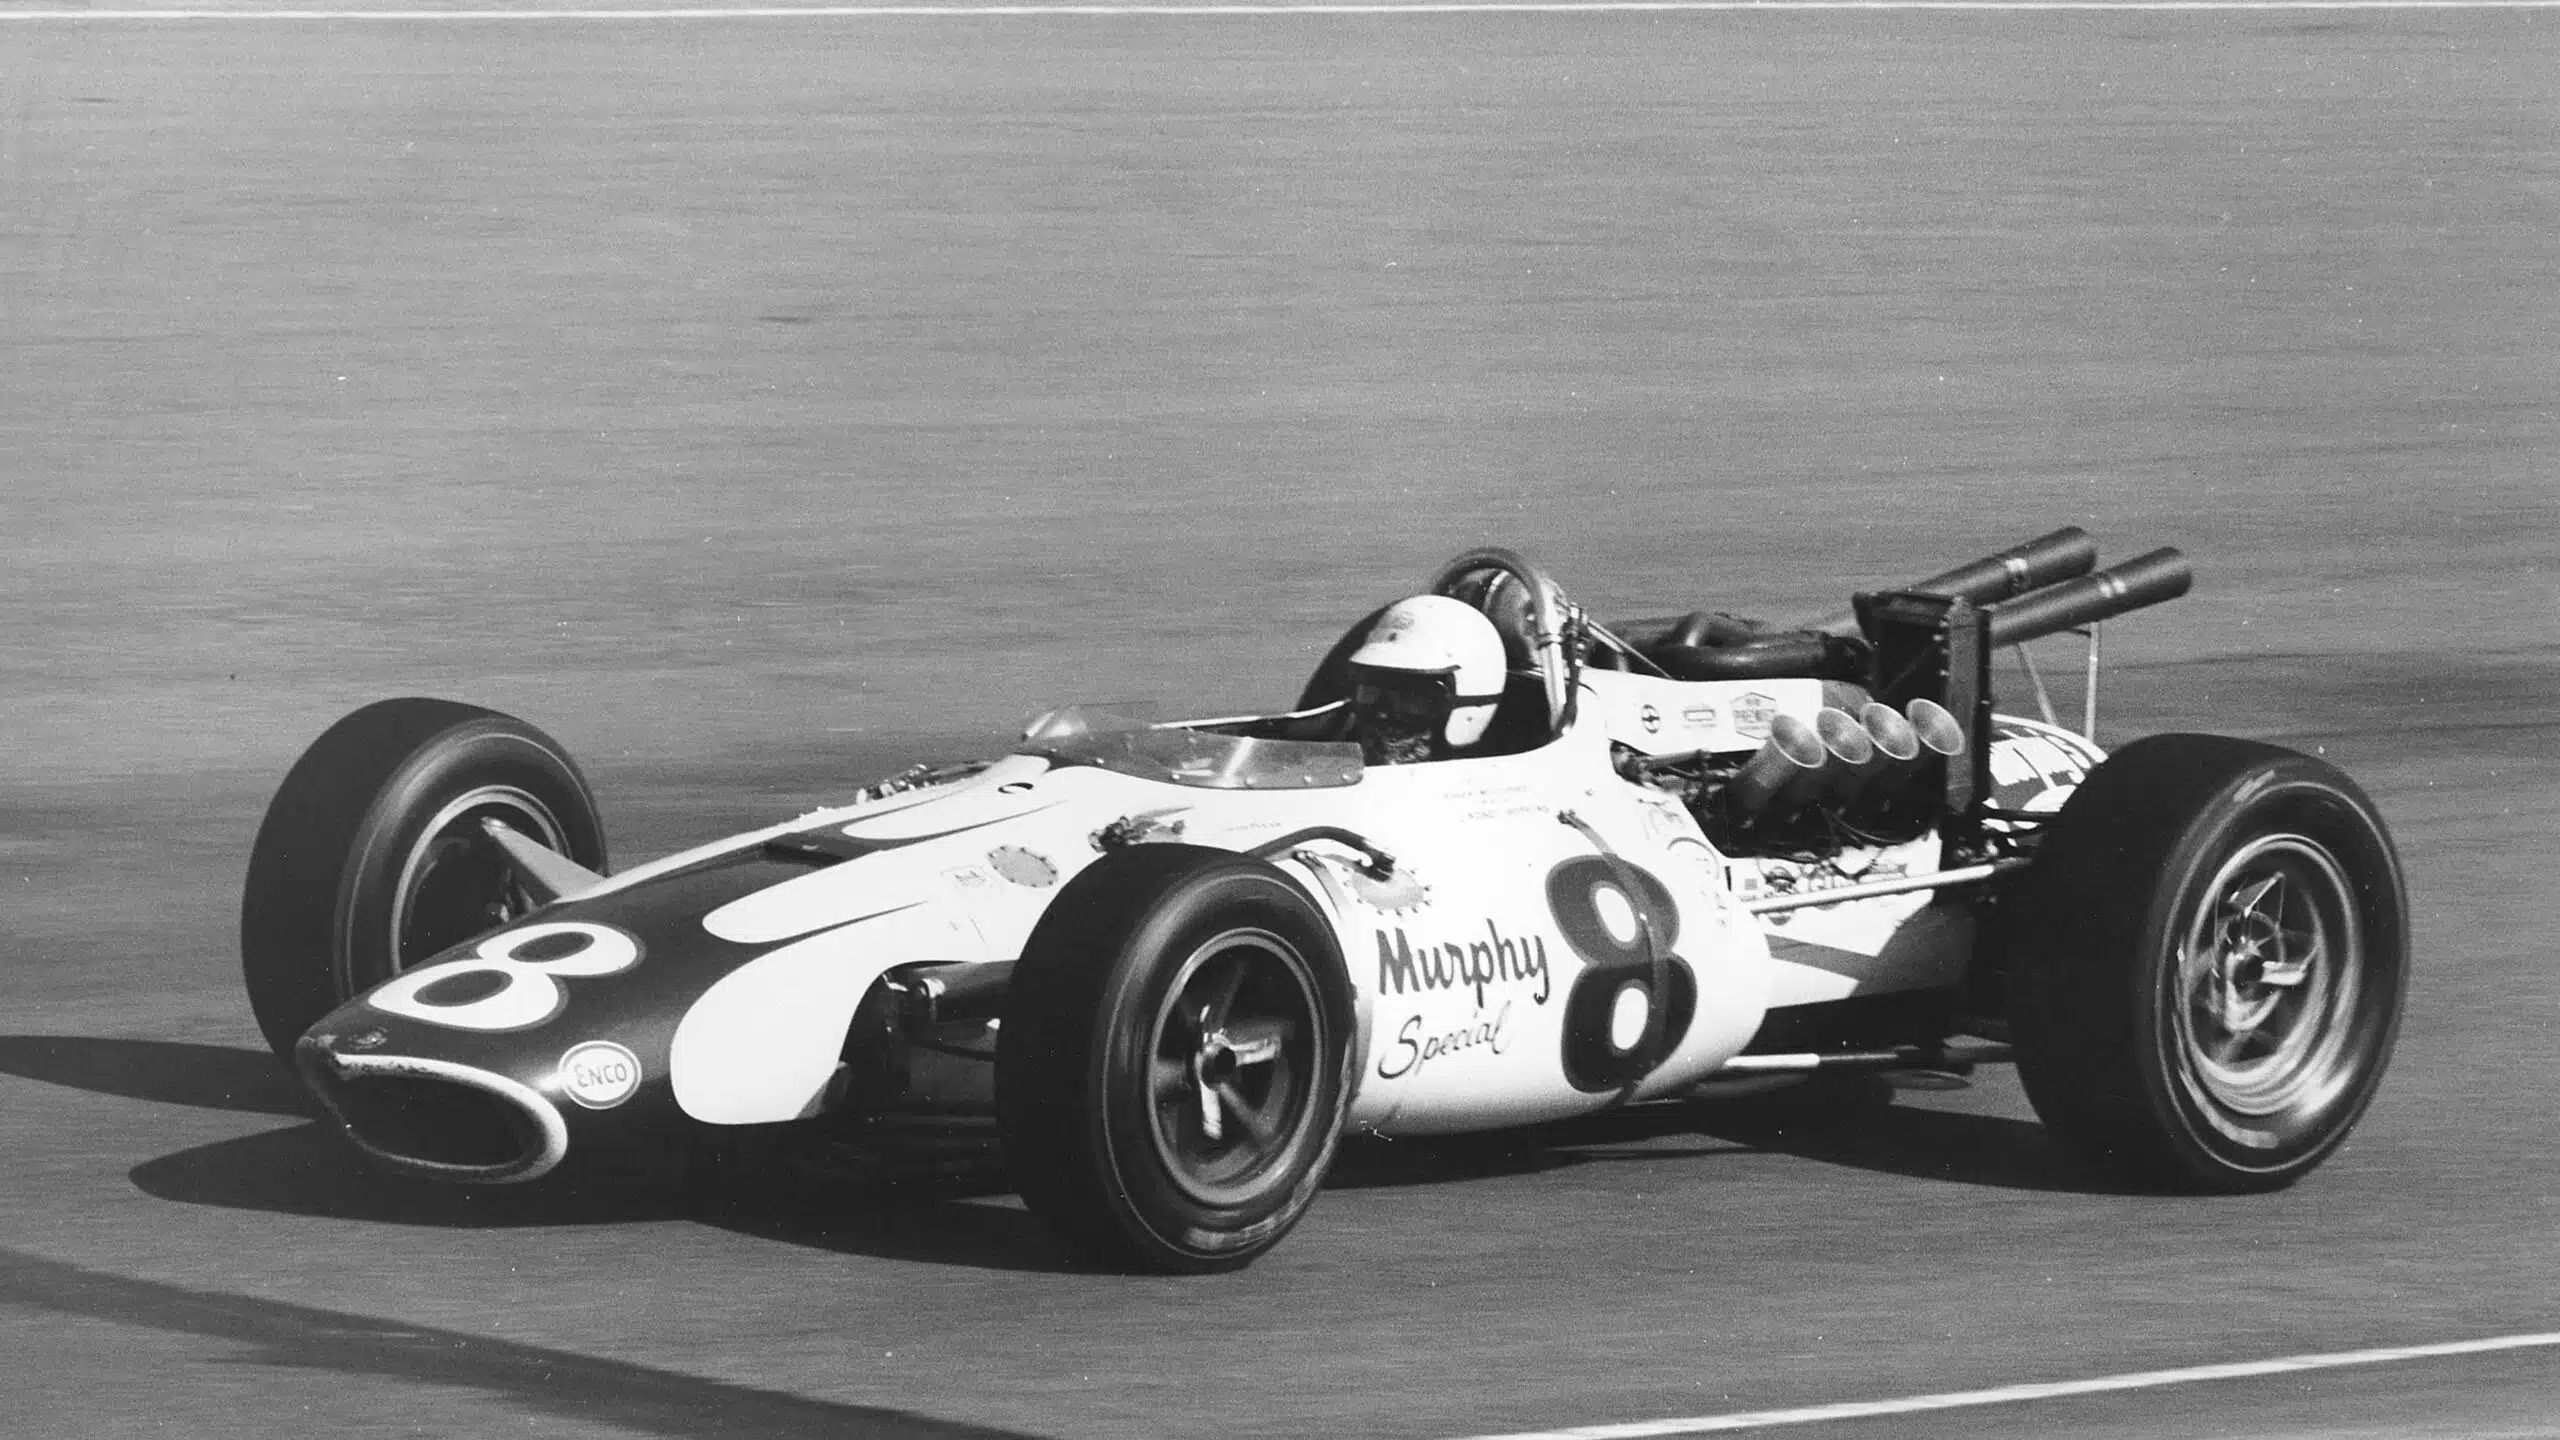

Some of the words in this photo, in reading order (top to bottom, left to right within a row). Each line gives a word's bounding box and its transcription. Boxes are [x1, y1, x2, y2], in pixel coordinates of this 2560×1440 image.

[368, 921, 638, 1030] 8
[1375, 918, 1550, 1008] Murphy
[1545, 854, 1698, 1094] 8
[573, 1060, 629, 1090] ENCO
[1377, 1000, 1512, 1079] Special
